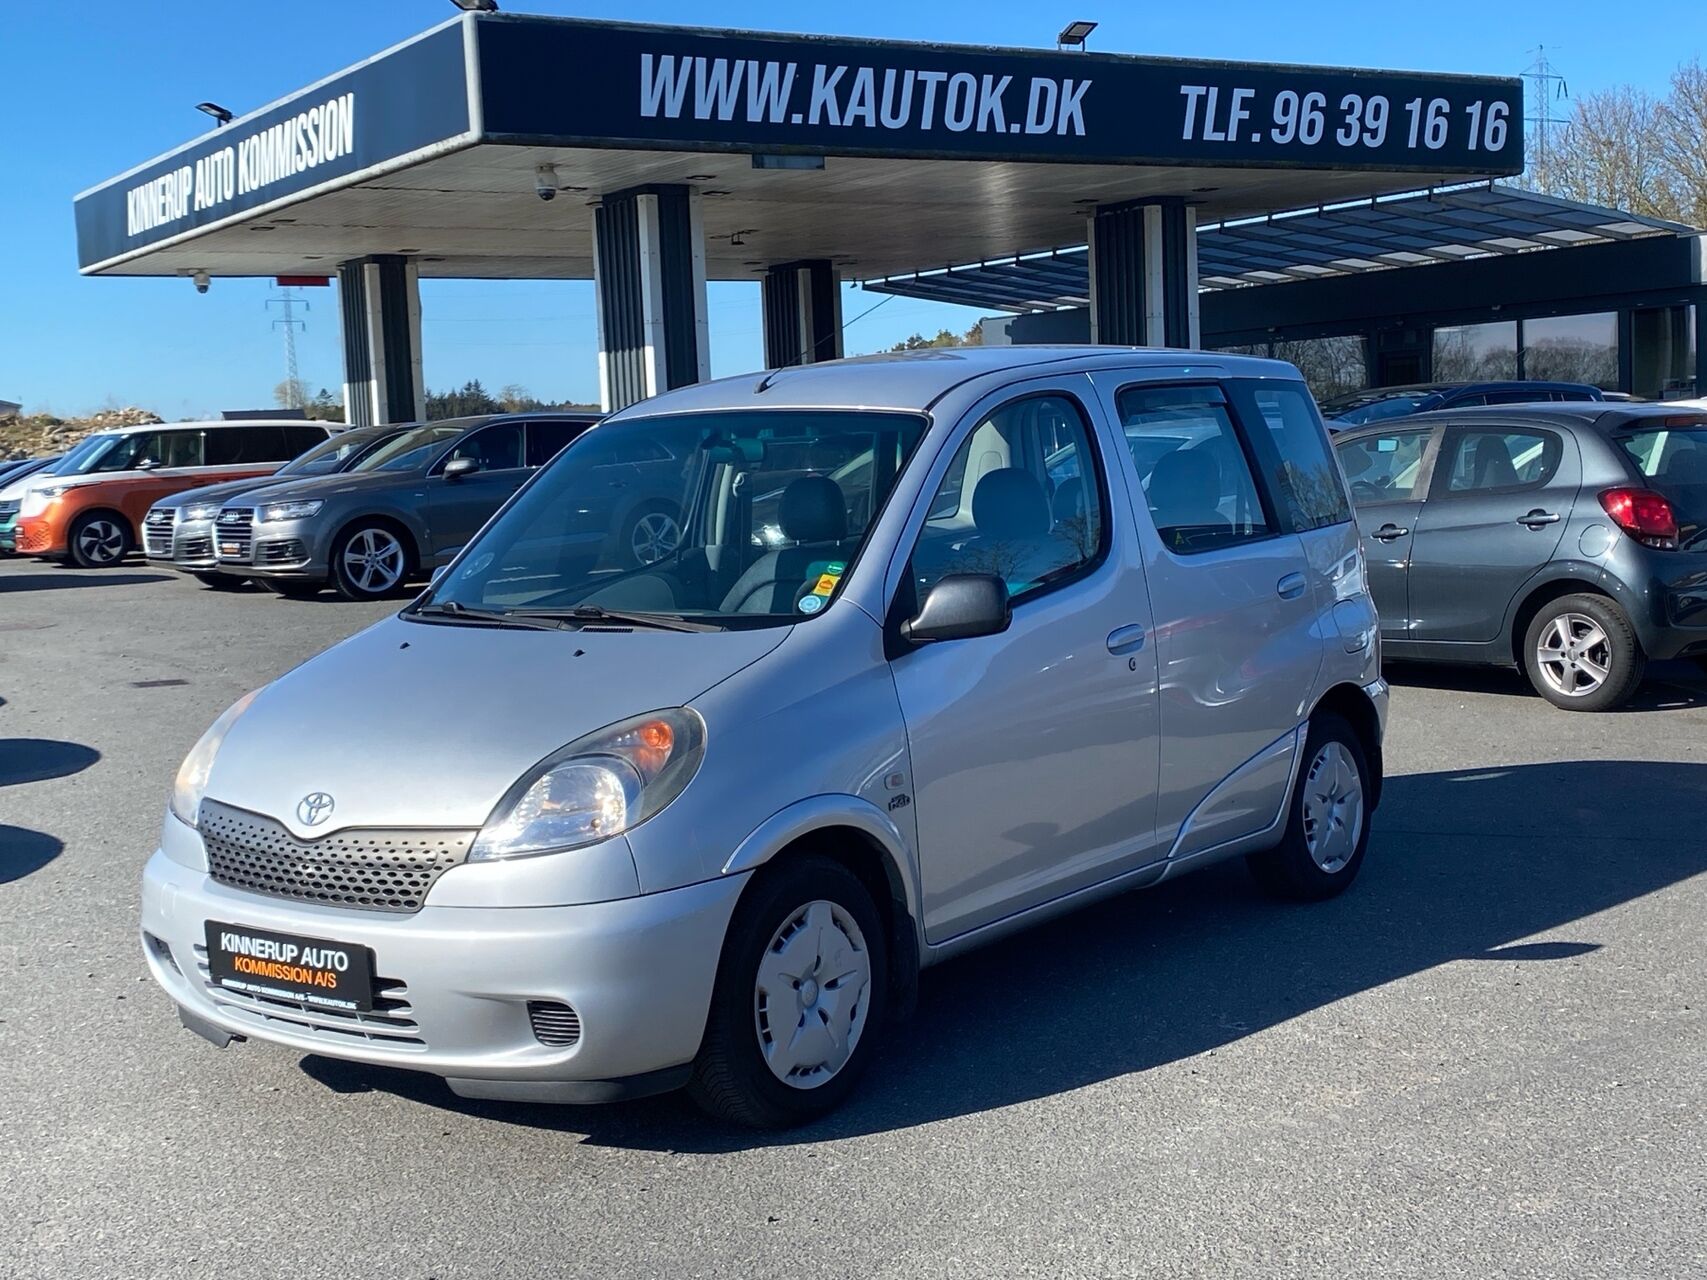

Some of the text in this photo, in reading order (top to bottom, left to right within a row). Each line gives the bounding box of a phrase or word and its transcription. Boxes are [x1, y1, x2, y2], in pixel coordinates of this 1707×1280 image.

[639, 53, 1093, 137] WWW.KAUTOK.DK
[1179, 85, 1510, 152] TLF. 96 39 16 16
[127, 92, 354, 237] KINNERUP AUTO KOMMISSION
[220, 931, 349, 972] KINNERUP AUTO
[234, 956, 313, 985] KOMMISSION
[314, 969, 337, 989] A/S
